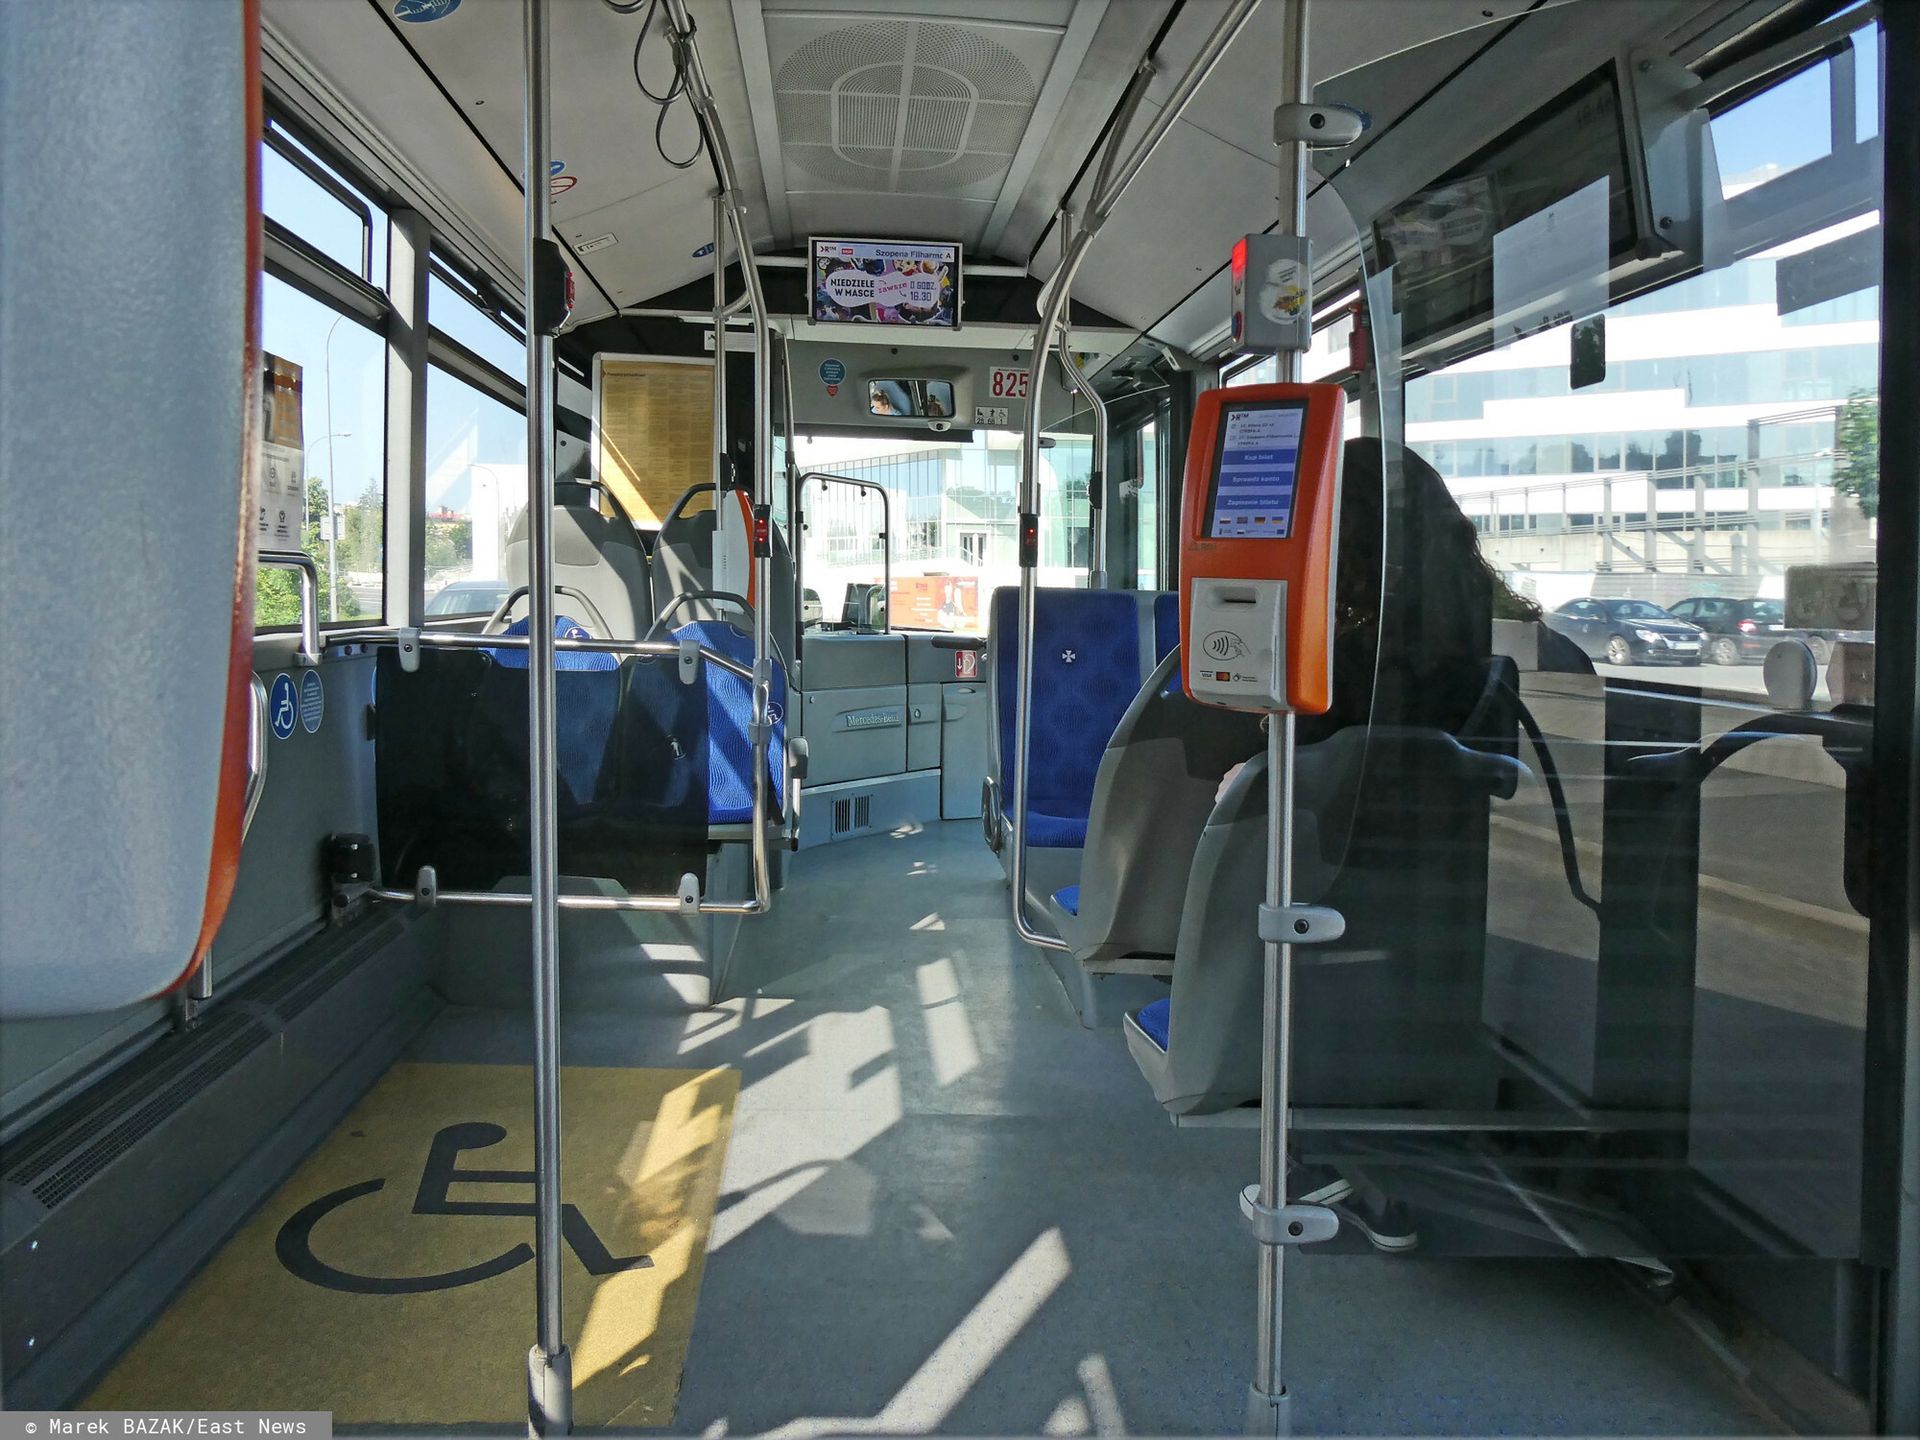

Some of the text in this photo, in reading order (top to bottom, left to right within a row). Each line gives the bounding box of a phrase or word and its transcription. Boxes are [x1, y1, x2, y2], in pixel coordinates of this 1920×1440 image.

[876, 249, 908, 258] Szopena
[830, 278, 875, 288] NIEDZIELE
[878, 282, 907, 294] zawsze
[917, 281, 937, 291] GODZ.
[835, 288, 875, 298] W MASCE
[910, 291, 932, 302] 18.30
[992, 371, 1029, 397] 825
